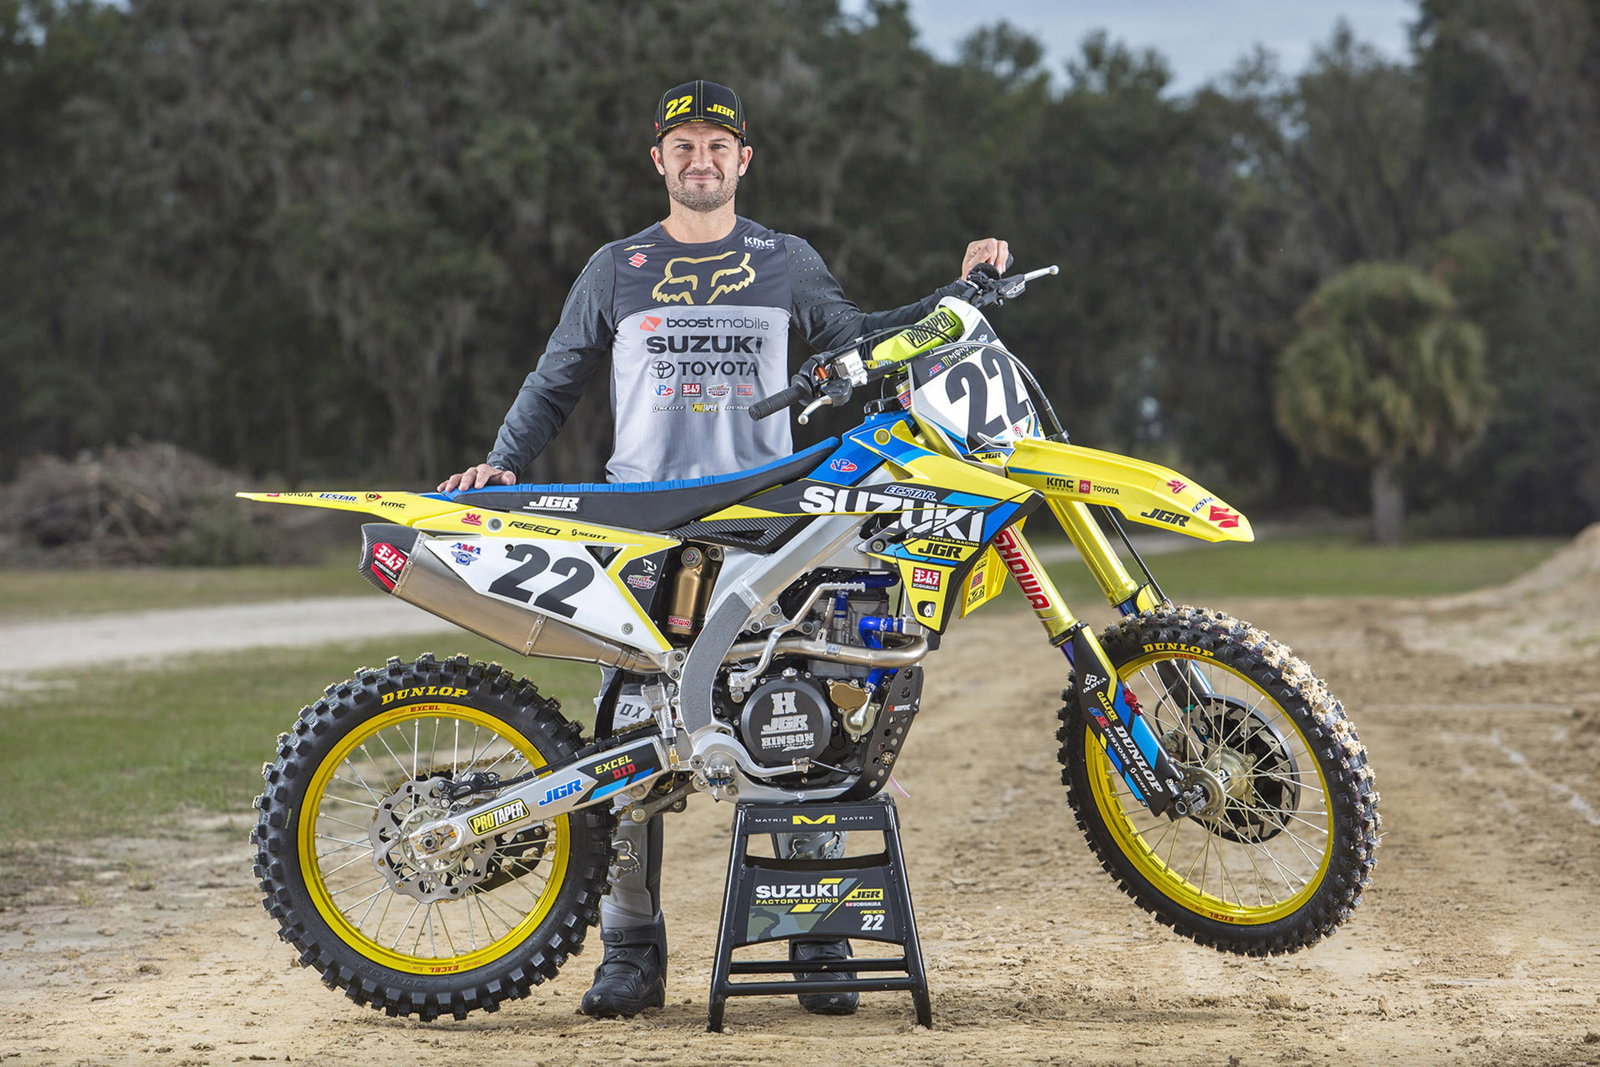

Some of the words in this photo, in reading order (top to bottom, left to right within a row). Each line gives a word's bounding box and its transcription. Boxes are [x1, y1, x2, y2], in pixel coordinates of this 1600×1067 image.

[665, 95, 693, 120] 22
[706, 104, 735, 120] JGR
[744, 236, 775, 247] KMC
[666, 316, 714, 329] boost
[716, 316, 770, 330] mobile
[646, 336, 762, 354] SUZUKI
[678, 361, 759, 377] TOYOTA
[945, 347, 1028, 453] 22
[980, 451, 1001, 460] JGR
[832, 460, 850, 470] VP
[1046, 477, 1074, 488] KMC
[1093, 485, 1120, 495] TOYOTA
[319, 492, 357, 502] ECSTAR
[884, 484, 938, 502] ECSTAR
[380, 500, 406, 508] KMC
[528, 496, 580, 510] JGR
[800, 486, 984, 543] SUZUKI
[1140, 508, 1191, 528] JGR
[508, 520, 561, 536] REED
[578, 532, 608, 540] SCOTT
[376, 544, 405, 570] ヨシムラ
[450, 542, 481, 556] AMA
[918, 542, 962, 559] JGR
[914, 568, 940, 586] ヨシムラ
[994, 530, 1051, 610] SHOWA
[488, 544, 595, 619] 22
[1142, 642, 1214, 657] DUNLOP
[381, 686, 468, 706] DUNLOP
[771, 691, 798, 716] H
[410, 704, 441, 712] EXCEL
[617, 700, 645, 719] OX
[1096, 691, 1118, 721] GALFER
[762, 714, 808, 732] JGR
[761, 732, 814, 747] HINSON
[1104, 727, 1131, 766] PISTONS
[595, 754, 632, 775] EXCEL
[1114, 725, 1164, 793] DUNLOP
[612, 764, 636, 779] DID
[1134, 770, 1152, 796] SCOTT
[538, 778, 584, 806] JGR
[472, 802, 524, 833] PROTAPER
[756, 884, 838, 898] SUZUKI
[852, 890, 880, 899] JGR
[861, 914, 884, 931] 22
[1208, 912, 1234, 922] EXCEL
[430, 965, 460, 973] EXCEL
